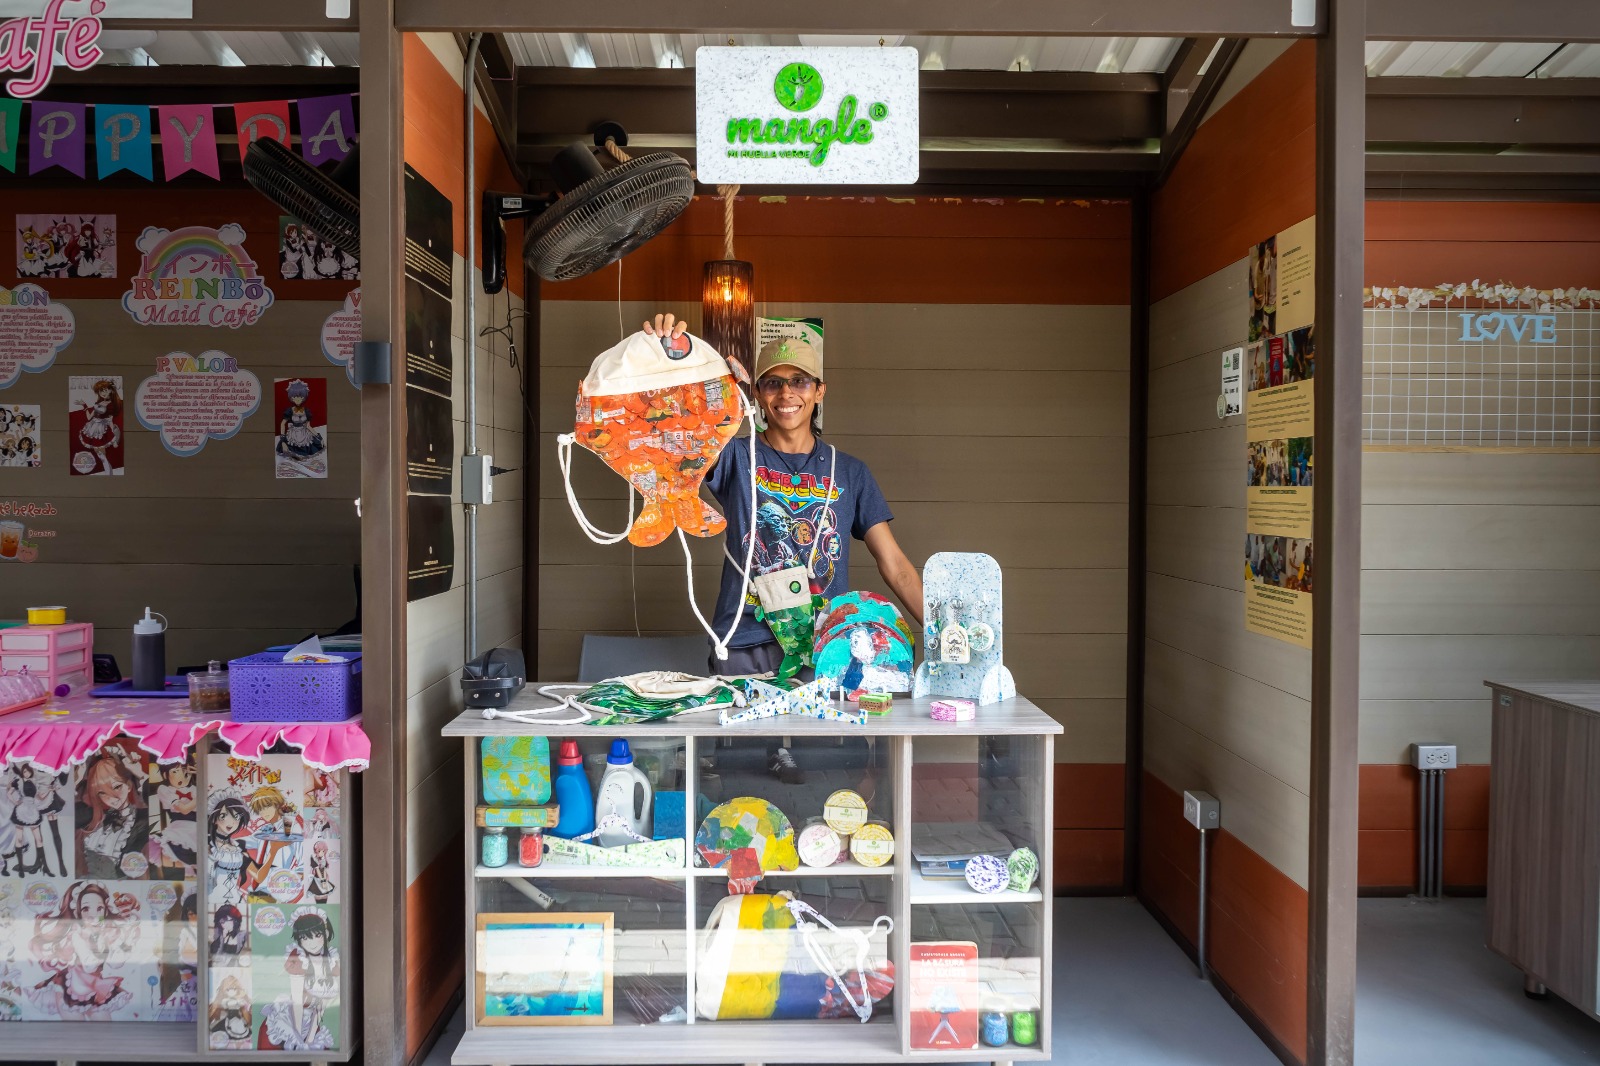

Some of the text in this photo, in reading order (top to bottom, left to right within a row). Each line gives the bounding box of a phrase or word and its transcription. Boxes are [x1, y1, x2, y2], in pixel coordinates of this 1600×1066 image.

[727, 150, 810, 159] MI HUELLA VERDE
[142, 254, 257, 275] レインボー
[143, 301, 258, 328] Maid Café
[156, 357, 239, 373] P. VALOR
[13, 501, 57, 517] helado
